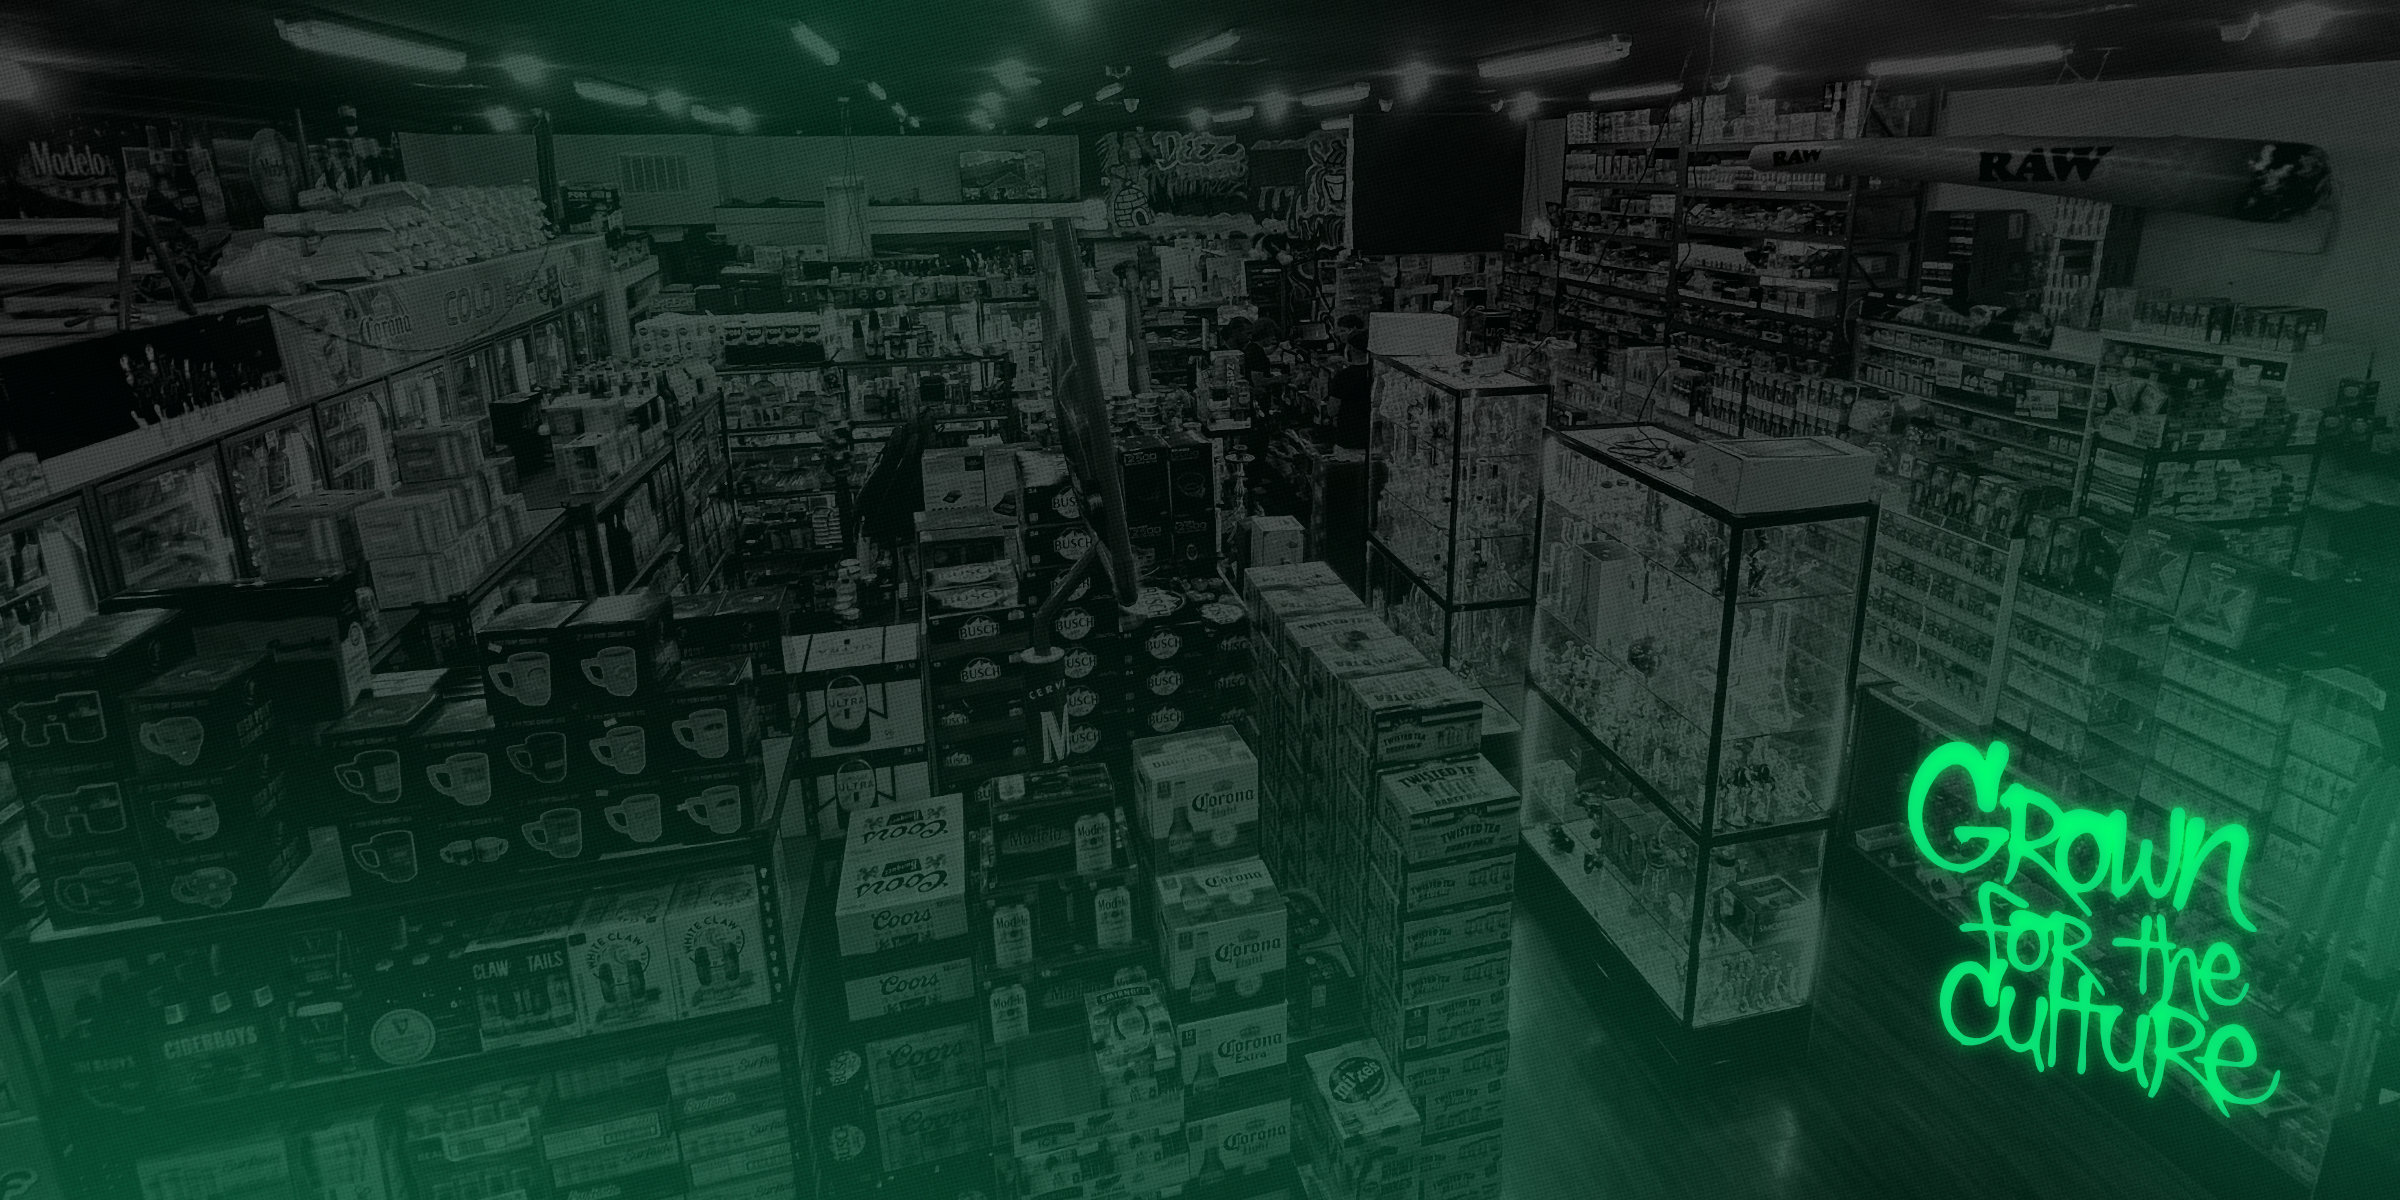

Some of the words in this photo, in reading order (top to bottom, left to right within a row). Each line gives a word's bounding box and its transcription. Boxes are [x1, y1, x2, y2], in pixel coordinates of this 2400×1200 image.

[29, 141, 108, 177] Modelo
[1772, 148, 1822, 166] RAW
[1978, 145, 2114, 183] RAW
[443, 282, 495, 327] COLD
[359, 313, 412, 345] Corona
[1054, 536, 1093, 551] BUSCH
[959, 622, 1000, 639] BUSCH
[1056, 615, 1095, 631] BUSCH
[1145, 634, 1182, 651] BUSCH
[1066, 656, 1098, 669] USCH
[961, 665, 1001, 682] BUSCH
[1147, 673, 1183, 689] BUSCH
[829, 696, 865, 709] ULTRA
[1068, 694, 1099, 708] USCH
[1147, 711, 1184, 726] BUSCH
[1383, 733, 1411, 746] TWISTED
[1413, 732, 1426, 741] TEA
[838, 780, 874, 792] ULTRA
[1398, 766, 1458, 787] TWISTED
[1192, 788, 1254, 814] Corona
[863, 818, 949, 845] Coors
[1010, 826, 1062, 847] Modelo
[1440, 824, 1482, 844] TWISTED
[1483, 822, 1501, 834] TEA
[855, 869, 949, 899] Coors
[1205, 870, 1263, 888] Corona
[1410, 880, 1442, 895] TWISTED
[871, 907, 932, 931] Coors
[683, 921, 702, 955] WHITE
[703, 915, 739, 931] CLAW
[1406, 928, 1439, 943] TWISTED
[587, 937, 606, 970] WHITE
[607, 931, 644, 947] CLAW
[1214, 937, 1281, 964] Corona
[473, 960, 509, 981] CLAW
[527, 951, 564, 973] TAILS
[1235, 953, 1263, 970] Light
[879, 972, 940, 996] Coors
[1405, 975, 1437, 990] TWISTED
[1436, 1000, 1468, 1015] TWISTED
[163, 1025, 258, 1061] CIDERBOYS
[1217, 1032, 1282, 1059] Corona
[887, 1038, 964, 1071] Coors
[1235, 1049, 1267, 1064] Extra
[834, 1050, 849, 1086] BUSCH
[683, 1092, 736, 1114] Surfside
[898, 1106, 977, 1136] Coors
[1223, 1123, 1287, 1151] Corona
[622, 1143, 674, 1163] Surfside
